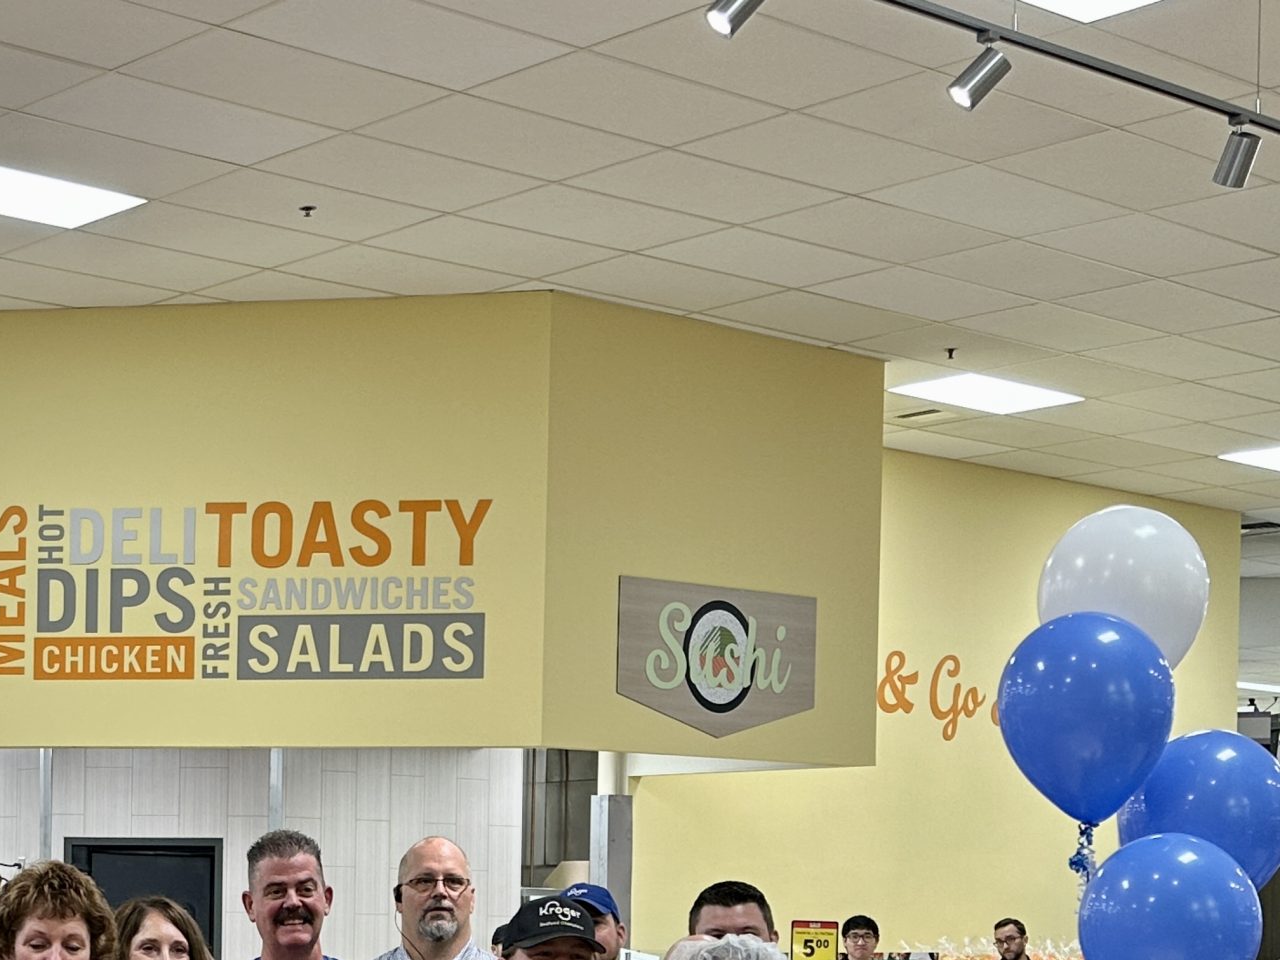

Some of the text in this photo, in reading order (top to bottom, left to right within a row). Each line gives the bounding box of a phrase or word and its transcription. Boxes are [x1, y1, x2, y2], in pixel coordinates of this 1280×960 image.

[37, 504, 65, 565] HOT
[69, 507, 197, 565] DELI
[205, 499, 494, 569] TOASTY
[36, 566, 197, 634] DIPS
[236, 576, 476, 611] SANDWICHES
[201, 577, 232, 679] FRESH
[247, 622, 476, 674] SALADS
[644, 601, 792, 693] Sushi
[42, 644, 187, 674] CHICKEN
[877, 650, 986, 741] & Go
[539, 901, 581, 921] Kroger
